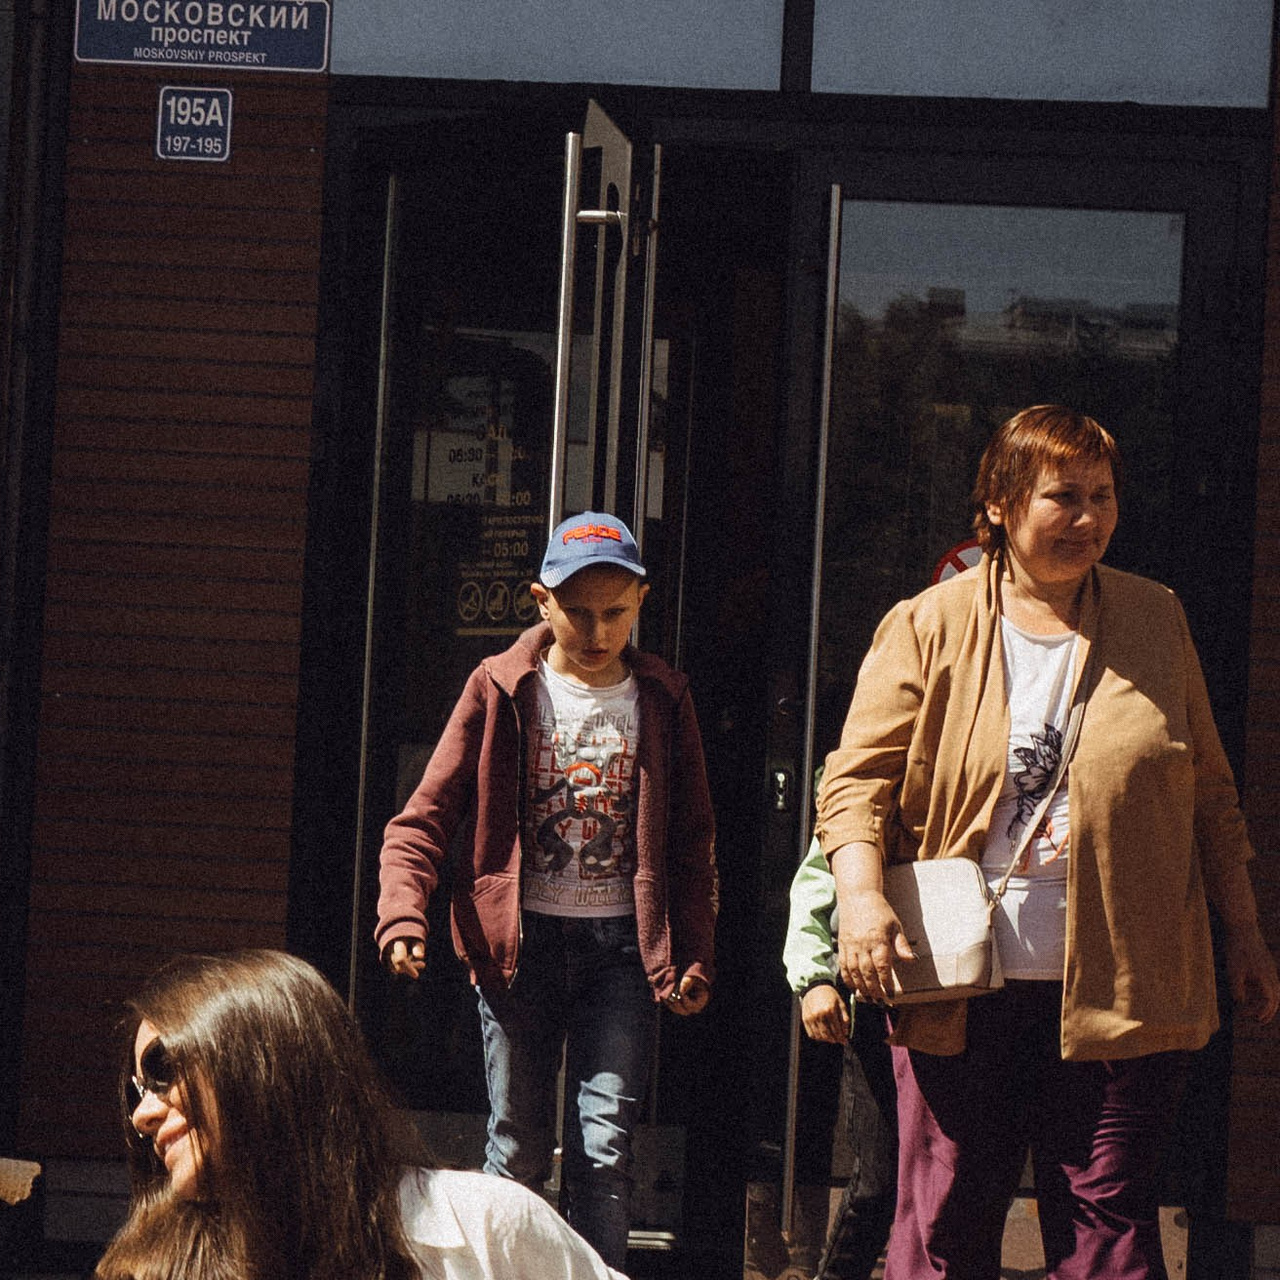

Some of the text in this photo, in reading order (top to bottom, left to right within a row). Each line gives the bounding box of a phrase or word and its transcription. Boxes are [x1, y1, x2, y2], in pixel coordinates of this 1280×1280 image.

[150, 25, 251, 47] проспект
[133, 47, 267, 64] MOSKOVSKIY PROSPEKT
[166, 96, 224, 127] 195А
[165, 135, 222, 154] 197-195
